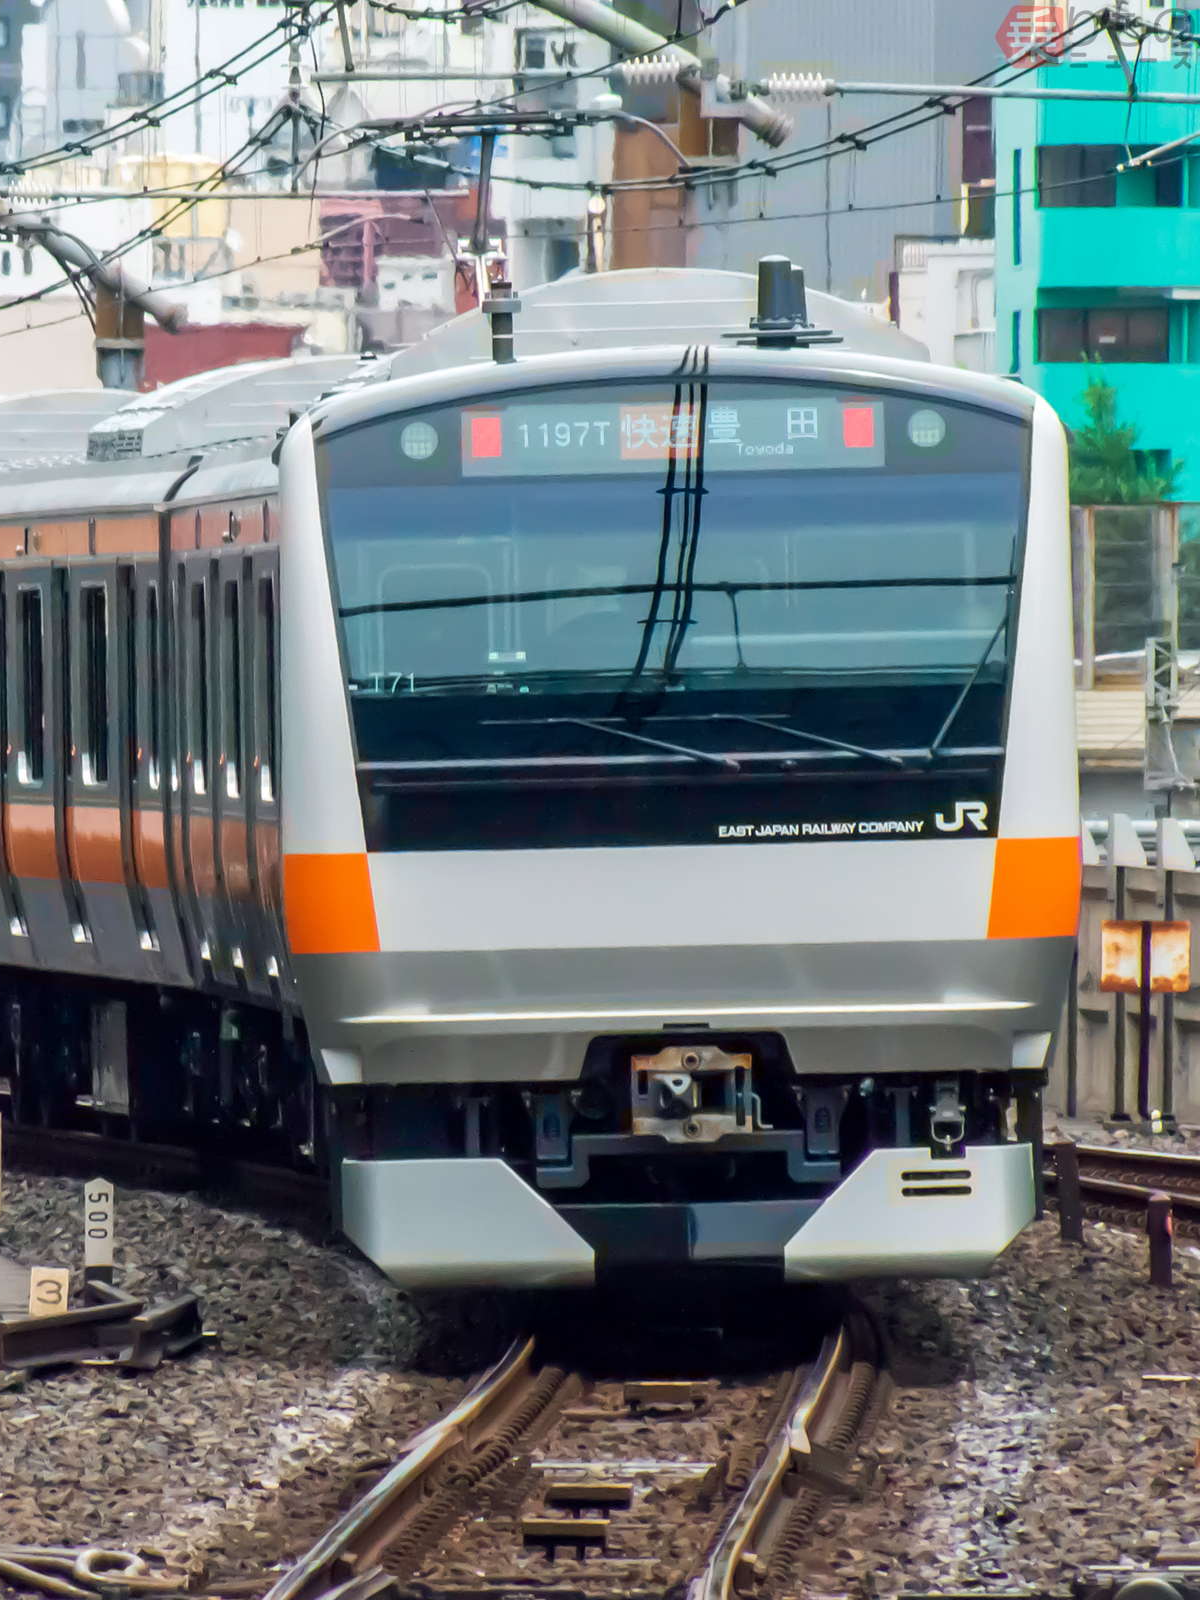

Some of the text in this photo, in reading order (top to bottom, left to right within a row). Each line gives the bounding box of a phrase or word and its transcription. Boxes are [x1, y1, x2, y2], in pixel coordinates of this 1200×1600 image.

[518, 421, 611, 448] 1197T
[621, 410, 697, 449] 快速
[736, 442, 795, 456] Toyoda
[718, 820, 924, 838] EAST JAPAN RAILWAY COMPANY
[935, 801, 989, 832] JR
[88, 1192, 109, 1239] 500
[36, 1279, 63, 1305] 3
